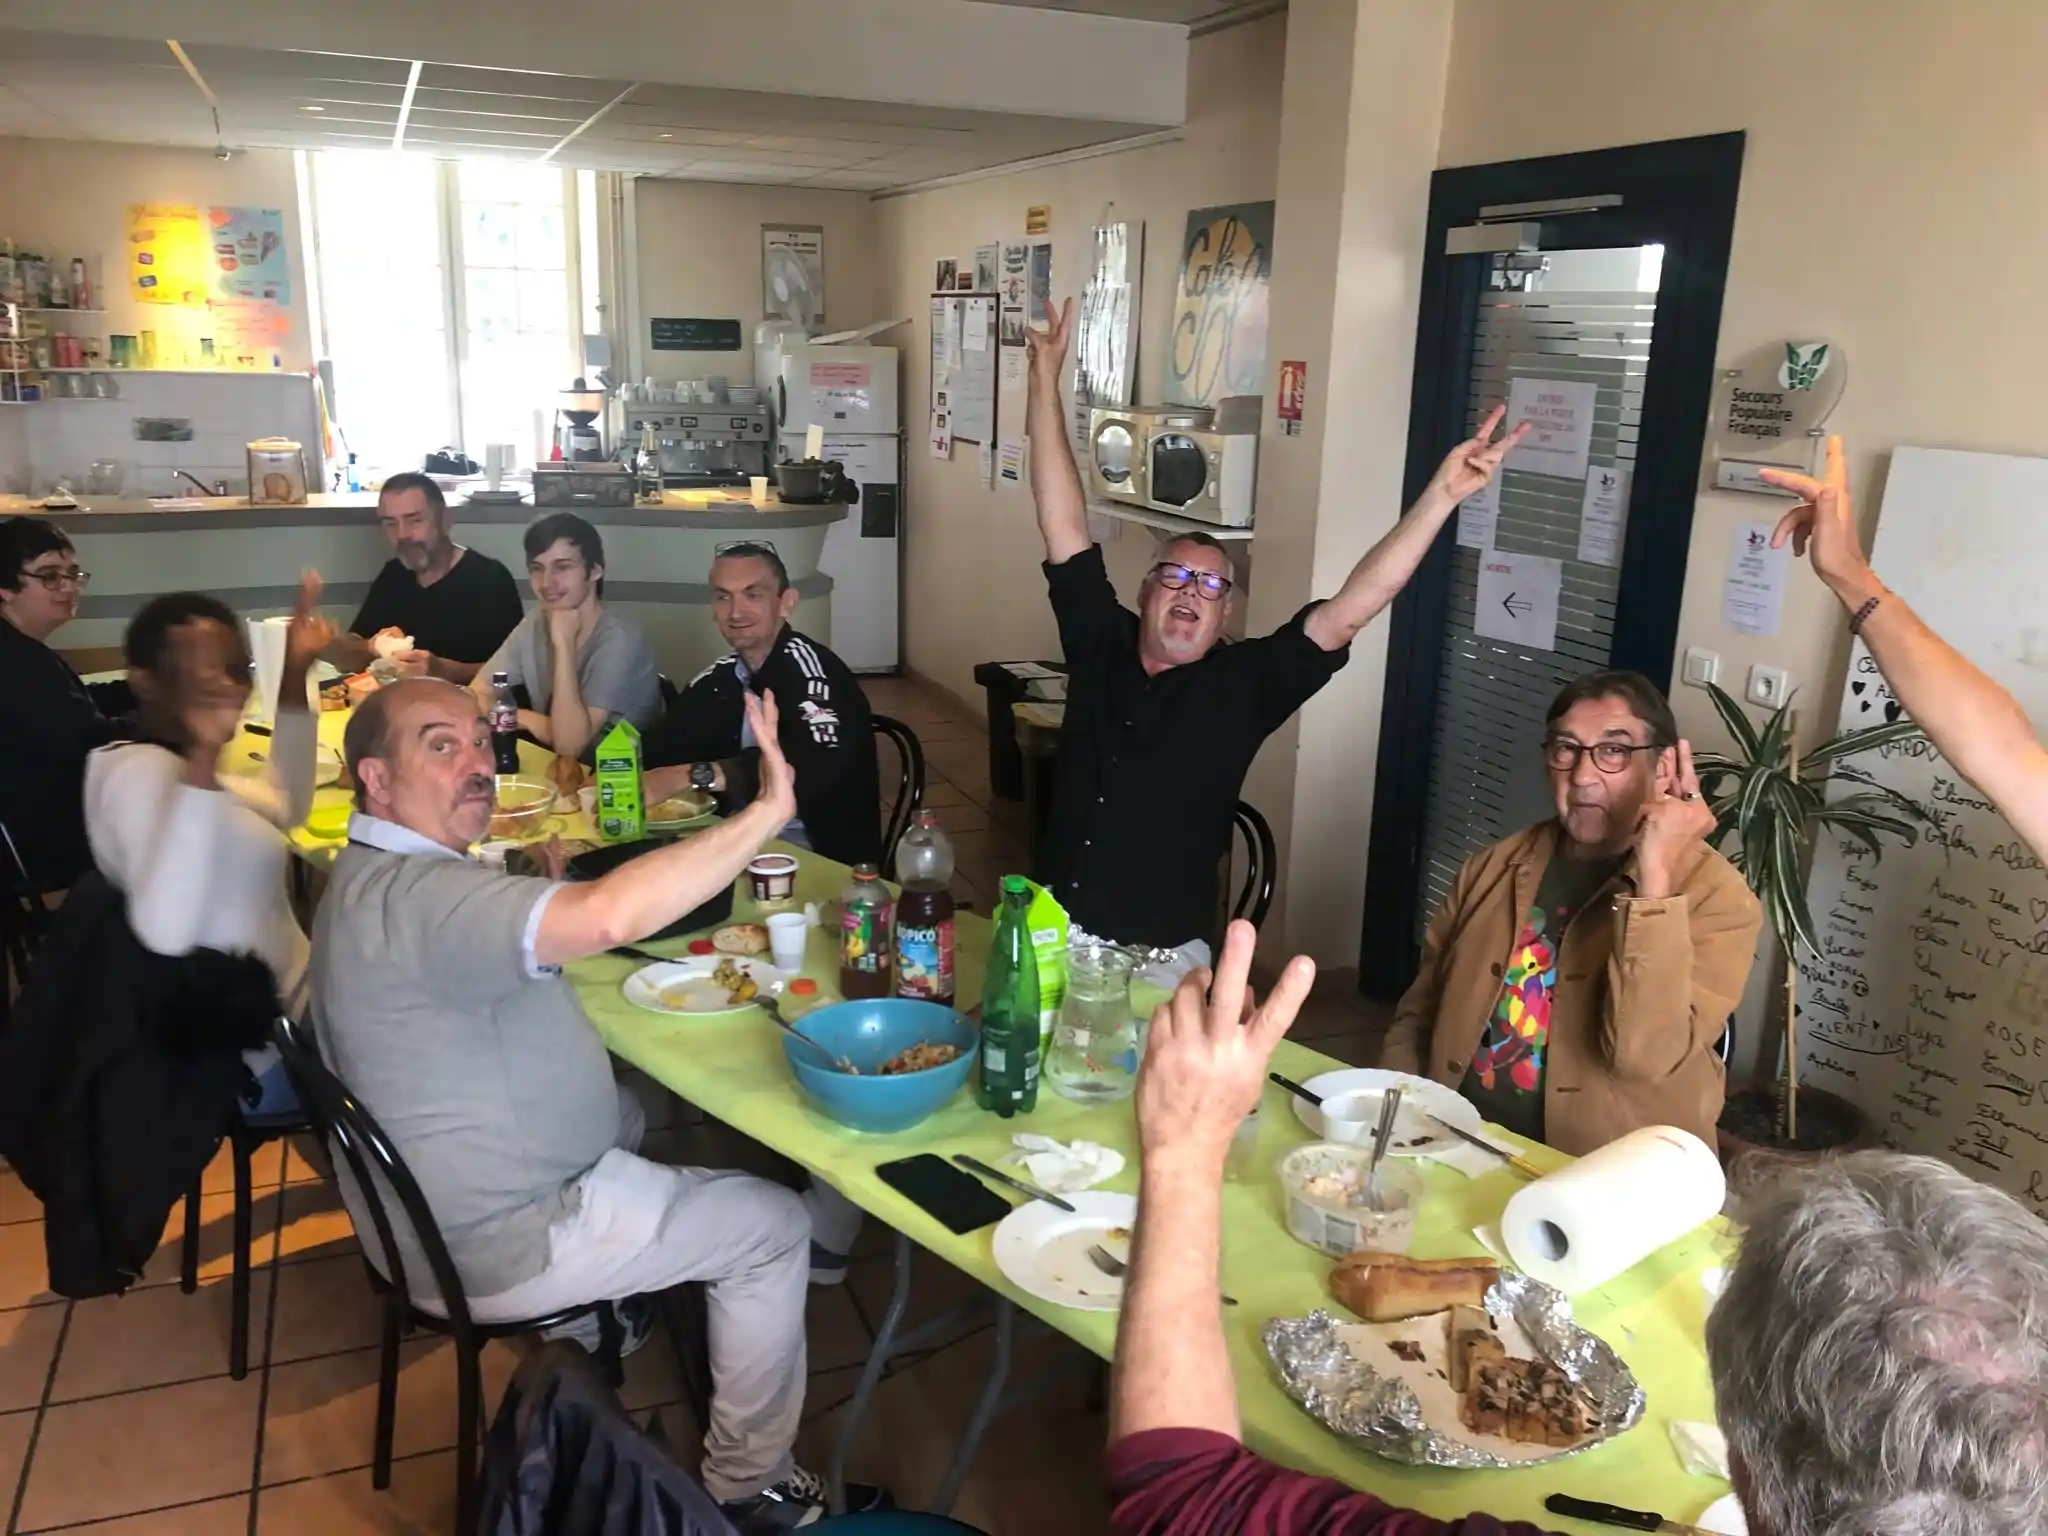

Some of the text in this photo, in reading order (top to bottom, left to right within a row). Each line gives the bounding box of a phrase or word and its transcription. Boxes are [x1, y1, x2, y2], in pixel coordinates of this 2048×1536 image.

[1731, 387, 1785, 405] Secours
[1728, 403, 1793, 423] Populaire
[1727, 419, 1782, 440] Français
[1960, 940, 2012, 969] LILY
[1985, 1020, 2046, 1058] ROSE
